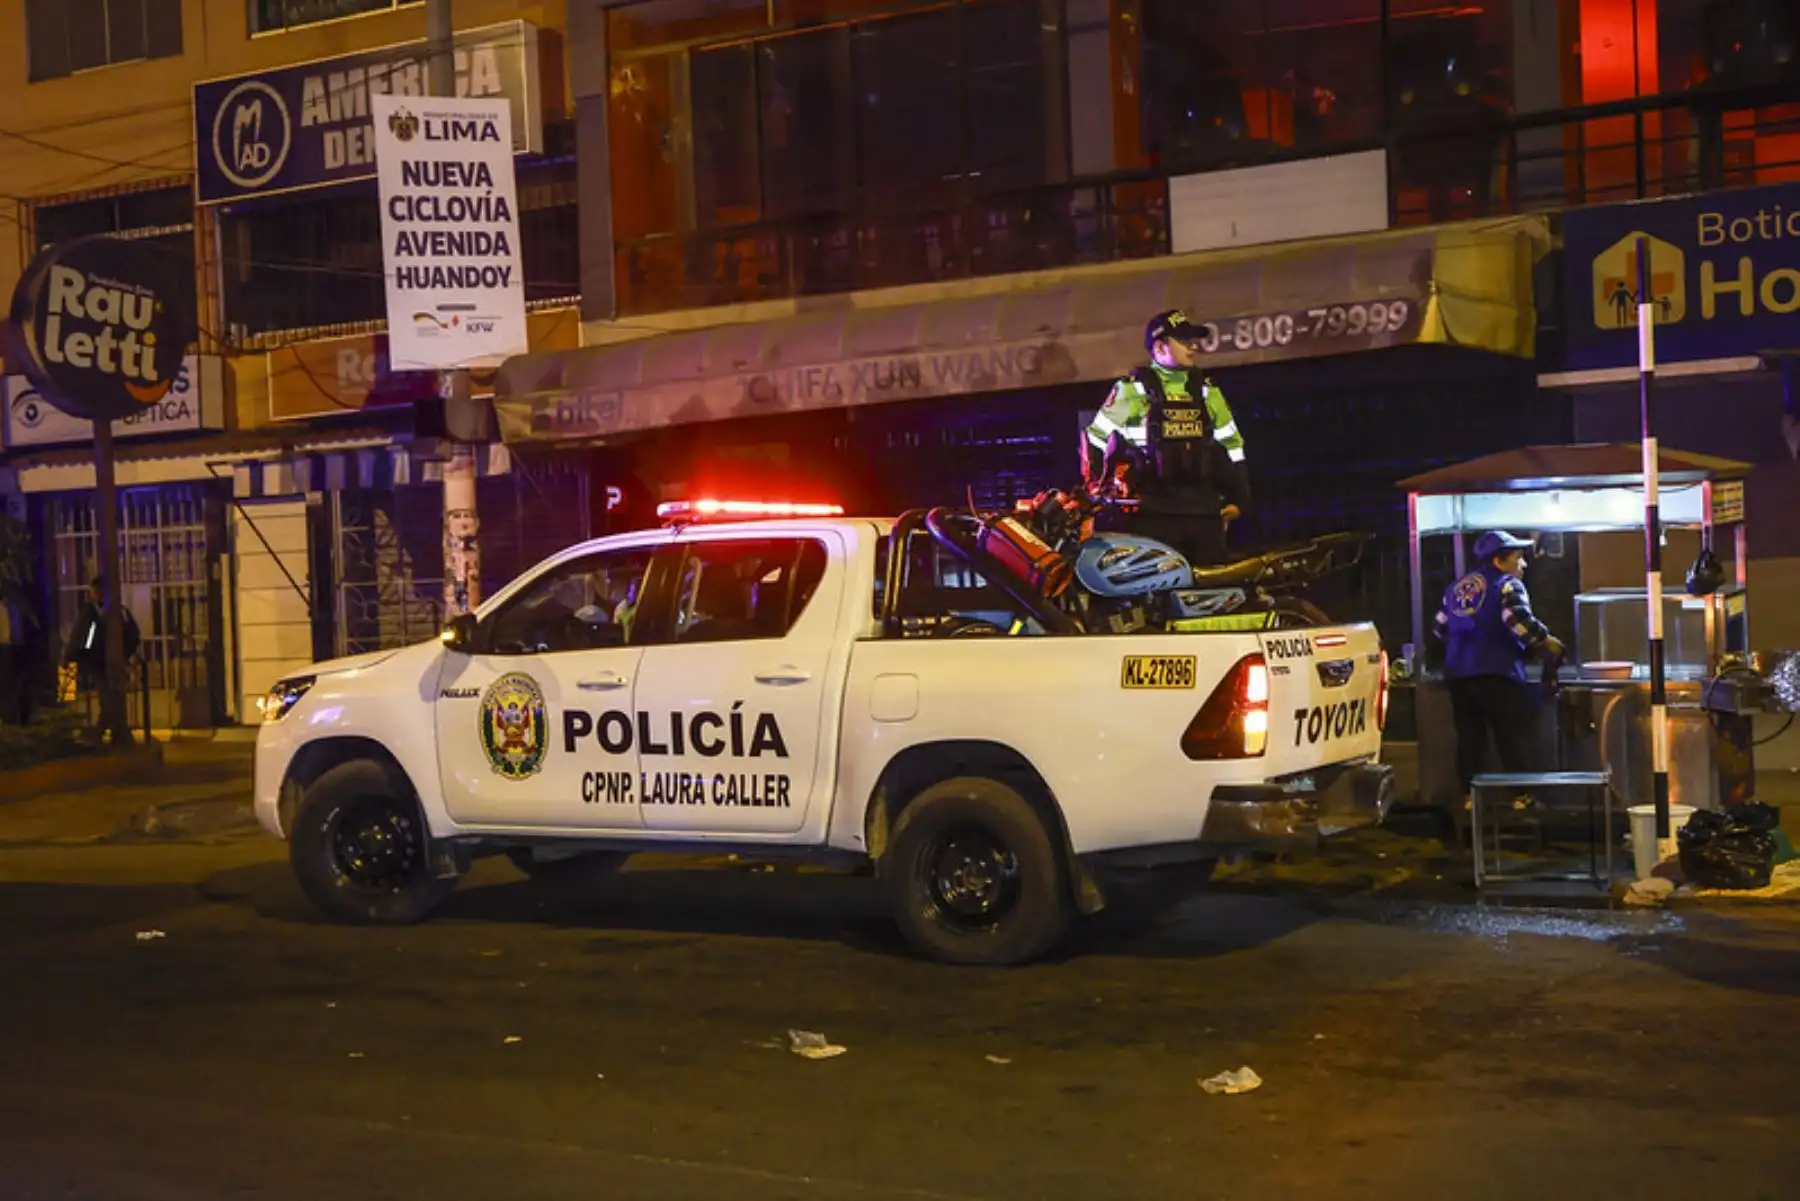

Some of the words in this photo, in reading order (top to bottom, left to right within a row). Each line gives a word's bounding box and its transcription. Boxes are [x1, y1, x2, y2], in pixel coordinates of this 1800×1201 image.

[424, 120, 501, 142] LIMA
[401, 160, 494, 187] NUEVA
[388, 190, 512, 222] CICLOVÍA
[394, 230, 511, 257] AVENIDA
[395, 265, 512, 289] HUANDOY
[1700, 256, 1800, 320] Ho
[48, 264, 154, 330] Rau
[44, 315, 158, 381] letti
[850, 354, 922, 393] XUN
[1124, 655, 1193, 687] KL-27896
[562, 700, 790, 758] POLICÍA
[1294, 697, 1366, 747] TOYOTA
[581, 770, 635, 804] CPNP.
[640, 772, 705, 806] LAURA
[711, 773, 791, 807] CALLER
